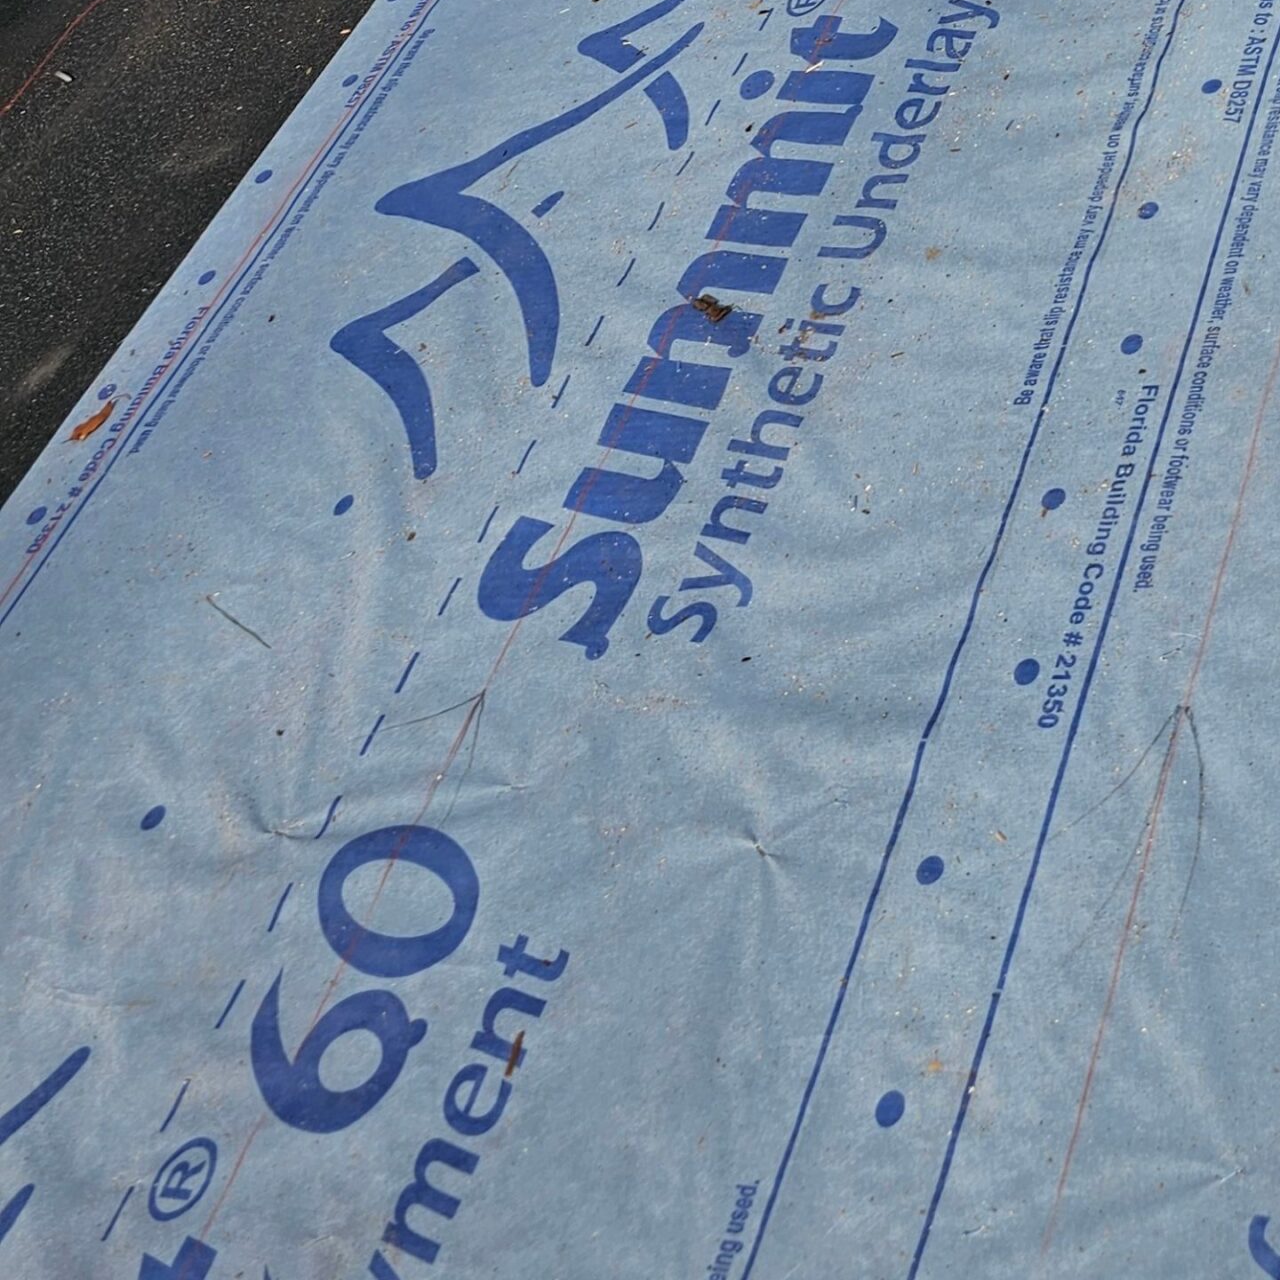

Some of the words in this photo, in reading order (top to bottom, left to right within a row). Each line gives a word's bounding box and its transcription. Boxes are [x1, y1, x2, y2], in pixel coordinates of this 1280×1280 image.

[398, 18, 417, 32] to
[1252, 12, 1273, 26] to
[368, 39, 402, 77] ASTM
[1235, 35, 1268, 77] ASTM
[1126, 61, 1146, 98] surface
[1222, 79, 1253, 124] D8257
[1106, 129, 1121, 149] on
[1086, 149, 1118, 203] dependent
[1246, 157, 1269, 179] may
[1239, 180, 1263, 203] vary
[1081, 204, 1104, 227] vary
[1226, 204, 1259, 259] dependent
[1072, 228, 1095, 249] may
[1052, 250, 1084, 304] resistance
[1222, 259, 1240, 275] on
[1042, 305, 1067, 330] slip
[1206, 276, 1235, 324] weather,
[162, 306, 211, 360] Florida
[1032, 327, 1055, 351] that
[1195, 325, 1222, 369] surface
[1022, 351, 1047, 387] aware
[108, 363, 170, 433] Building
[1012, 388, 1035, 406] Be
[1176, 370, 1208, 436] conditions
[1120, 384, 1160, 457] Florida
[77, 437, 118, 482] Code
[647, 272, 861, 644] Synthetic
[1172, 437, 1190, 452] or
[1156, 453, 1190, 512] footwear
[25, 502, 73, 554] 21350
[1085, 462, 1136, 556] Building
[1139, 514, 1173, 552] being
[1068, 562, 1104, 625] Code
[1132, 554, 1157, 593] used.
[1061, 631, 1084, 647] #
[1036, 653, 1077, 729] 21350
[250, 824, 480, 1133] 60
[726, 1179, 760, 1234] used.
